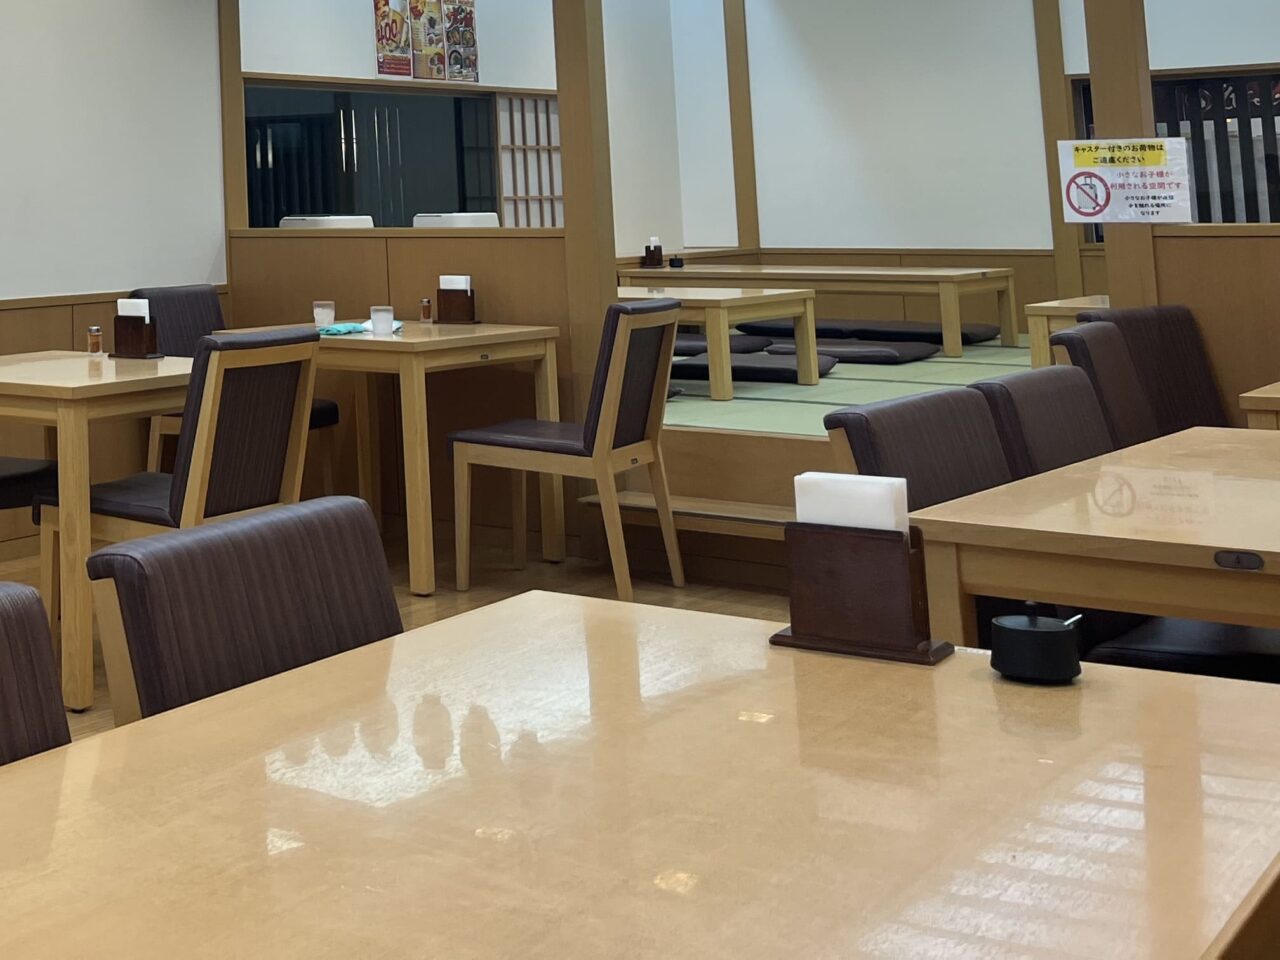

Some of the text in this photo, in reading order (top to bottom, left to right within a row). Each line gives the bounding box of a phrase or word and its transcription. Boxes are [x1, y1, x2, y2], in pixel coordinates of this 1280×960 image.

[1074, 144, 1164, 153] キャスター付きのお荷物は
